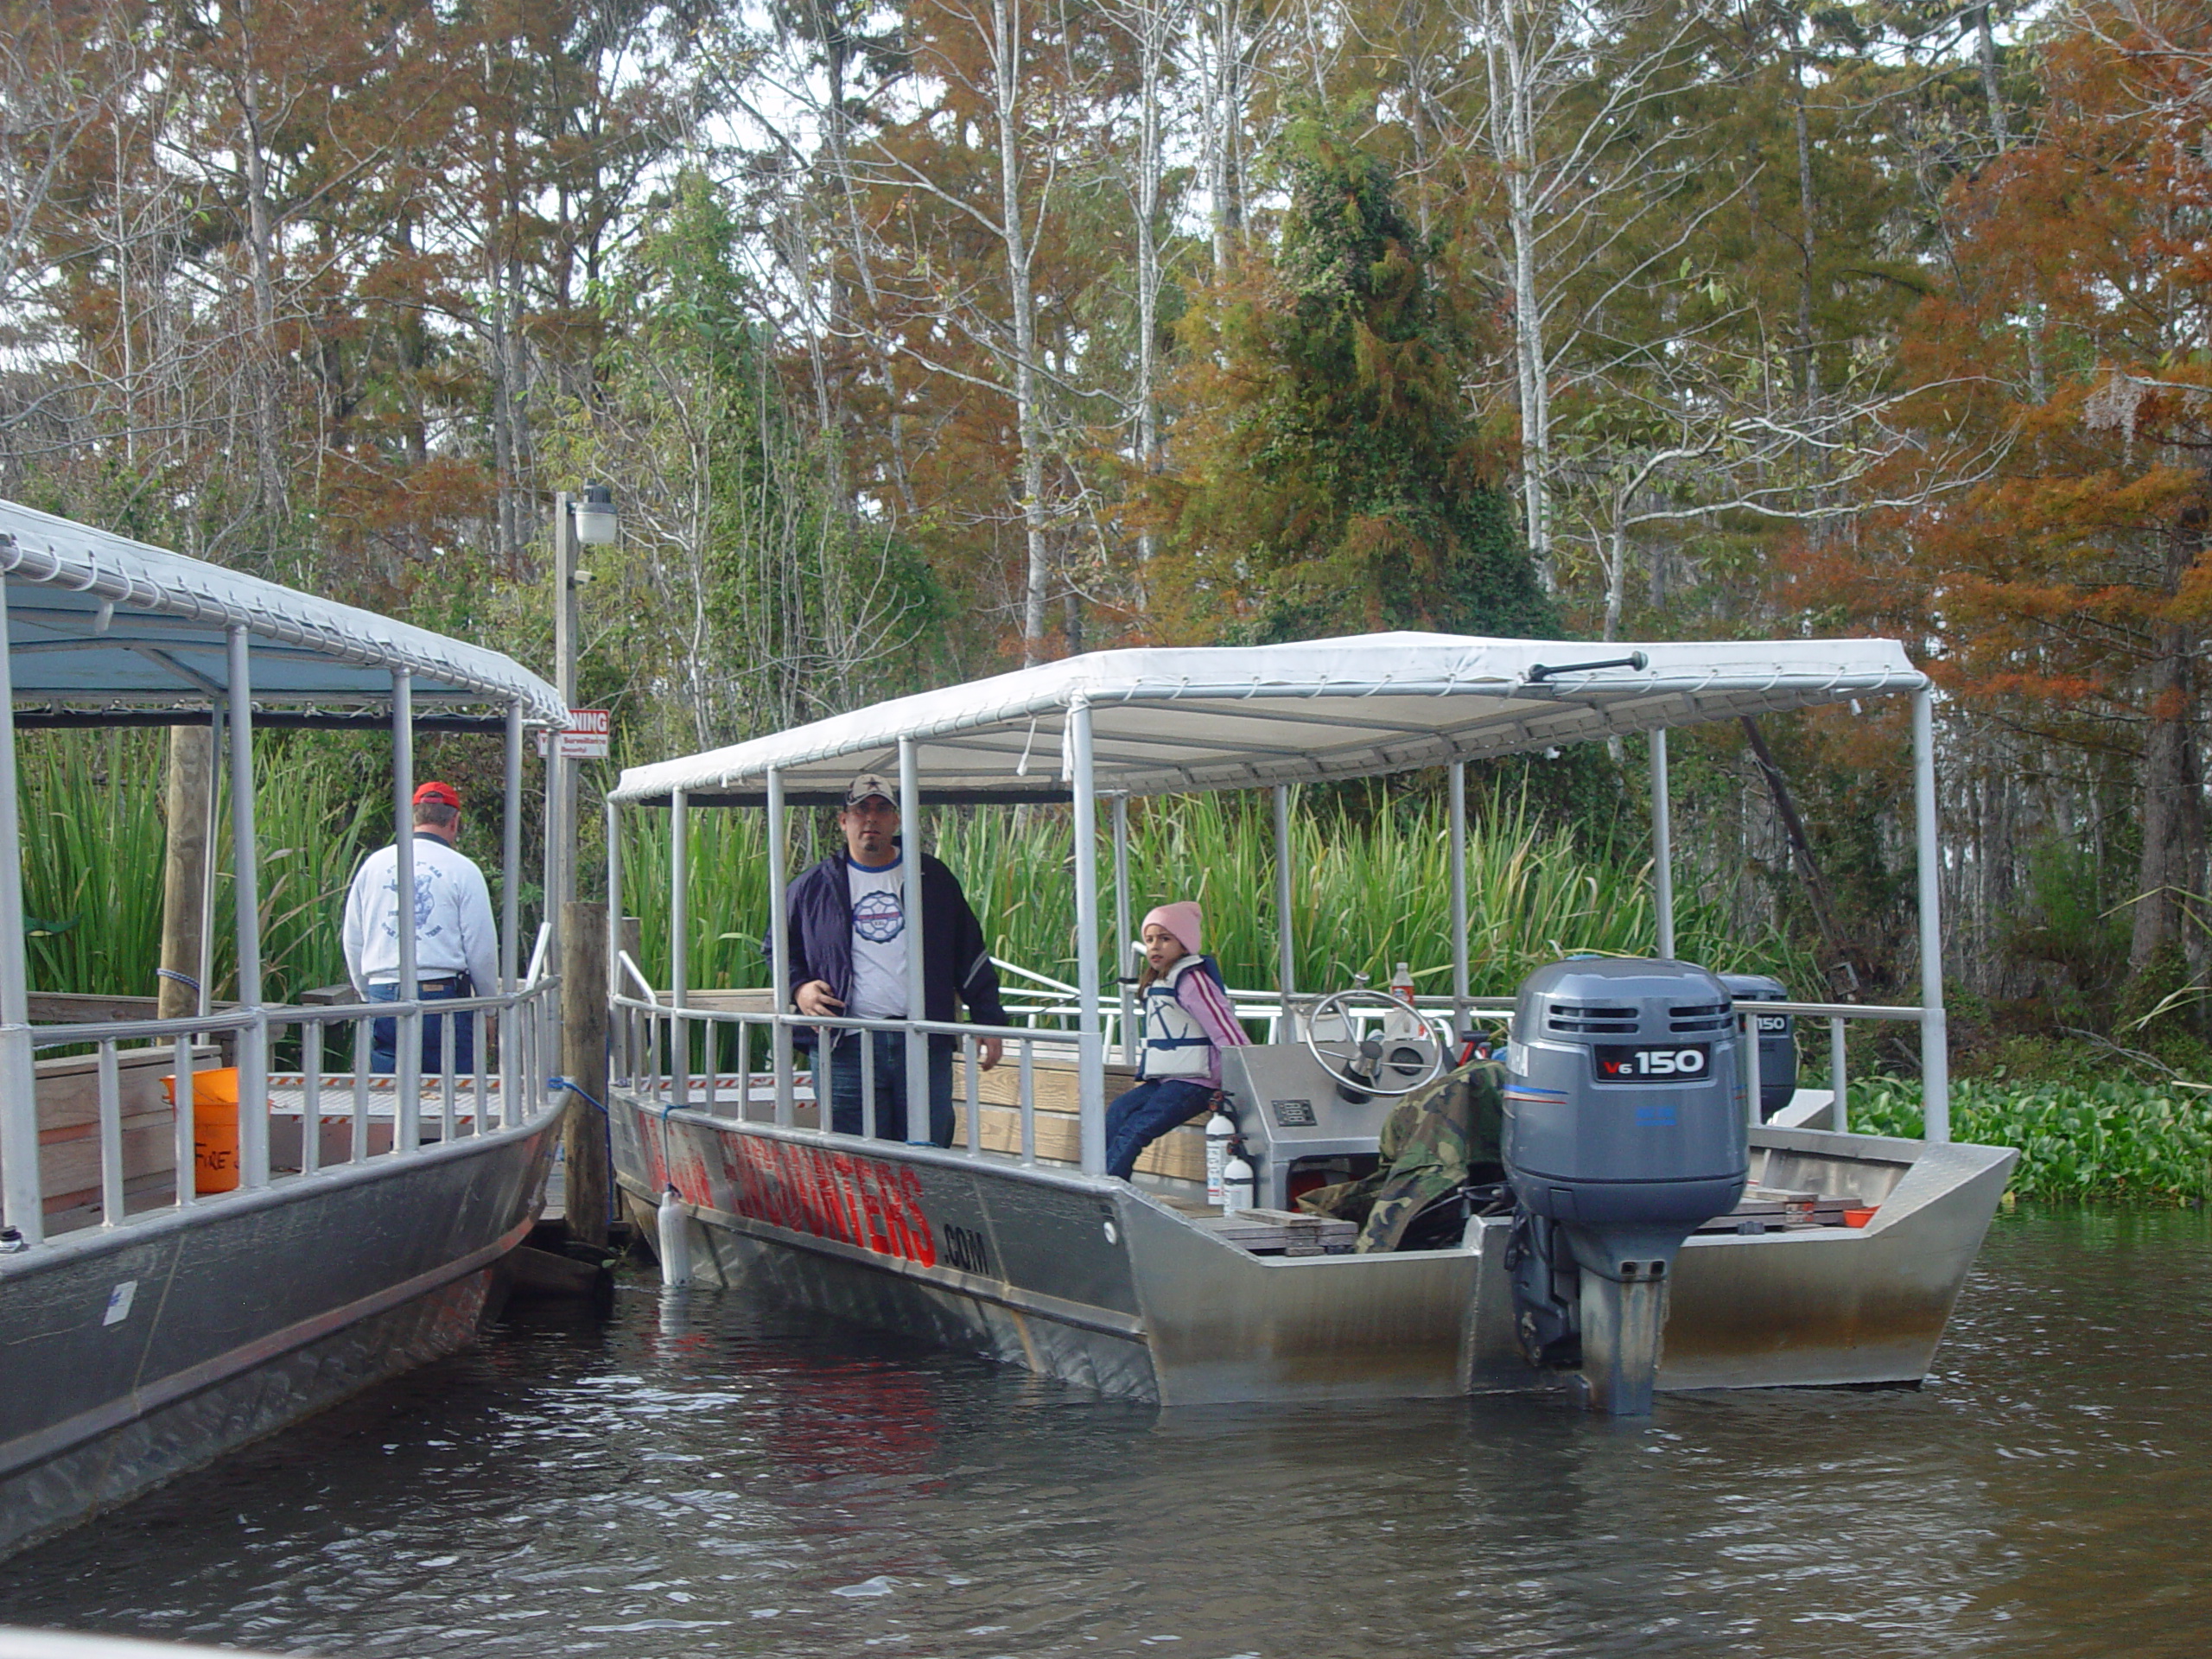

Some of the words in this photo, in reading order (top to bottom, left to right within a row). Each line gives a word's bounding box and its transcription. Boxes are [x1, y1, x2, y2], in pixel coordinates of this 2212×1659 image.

[572, 713, 607, 732] NING
[1757, 1016, 1785, 1030] 150
[1603, 1061, 1633, 1075] V6
[1634, 1049, 1705, 1075] 150
